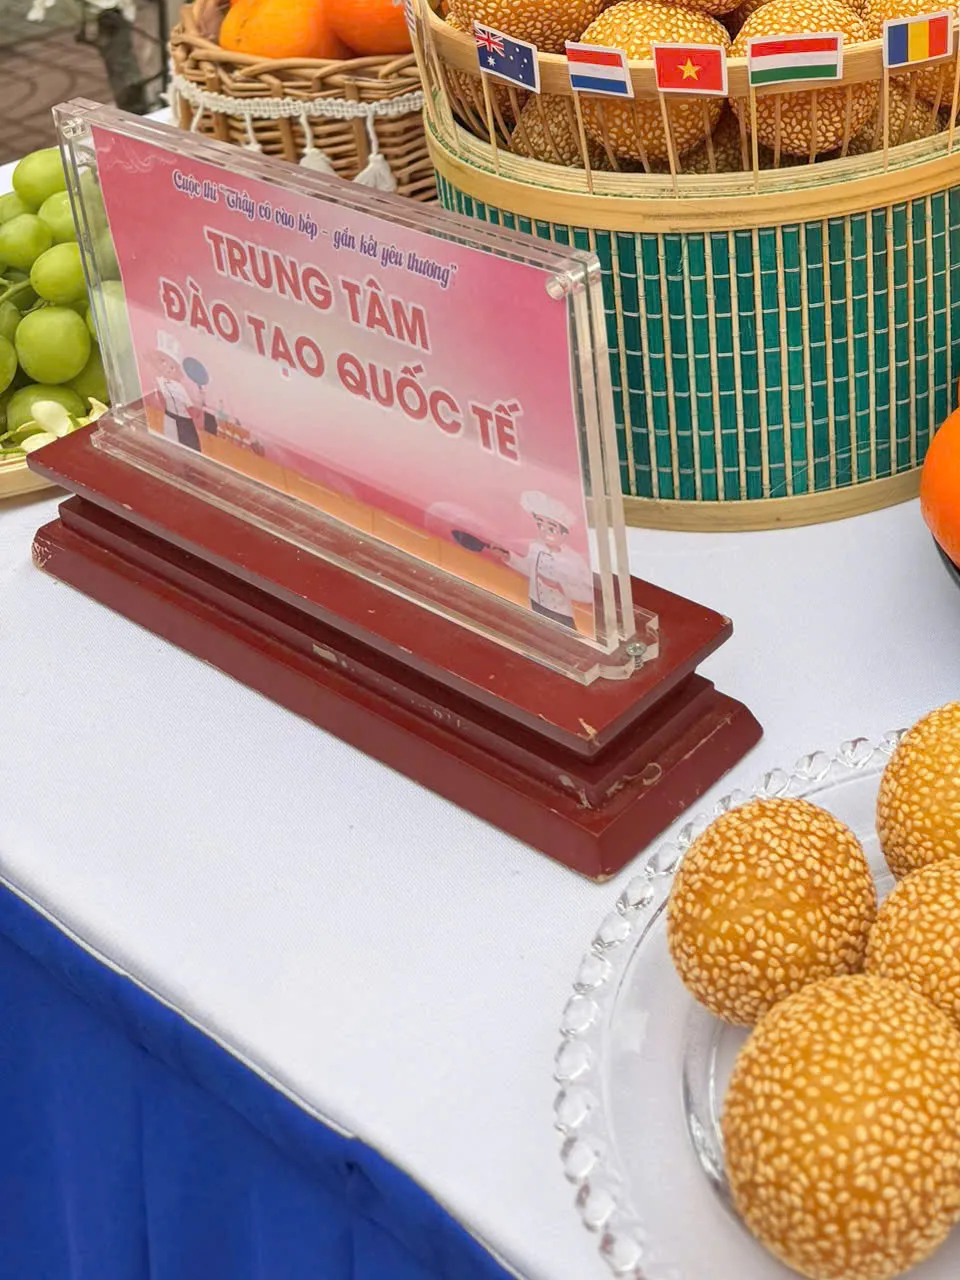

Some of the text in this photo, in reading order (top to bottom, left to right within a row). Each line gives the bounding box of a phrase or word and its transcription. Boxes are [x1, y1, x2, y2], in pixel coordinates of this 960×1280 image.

[173, 170, 201, 198] Cuộc
[203, 180, 217, 201] thi
[258, 202, 271, 220] cô
[275, 207, 295, 229] vào
[298, 213, 318, 240] bếp
[360, 234, 378, 258] kết
[381, 245, 403, 268] yêu
[206, 230, 430, 351] TRUNG TÂM
[161, 280, 521, 462] ĐÀO TẠO QUỐC TẾ
